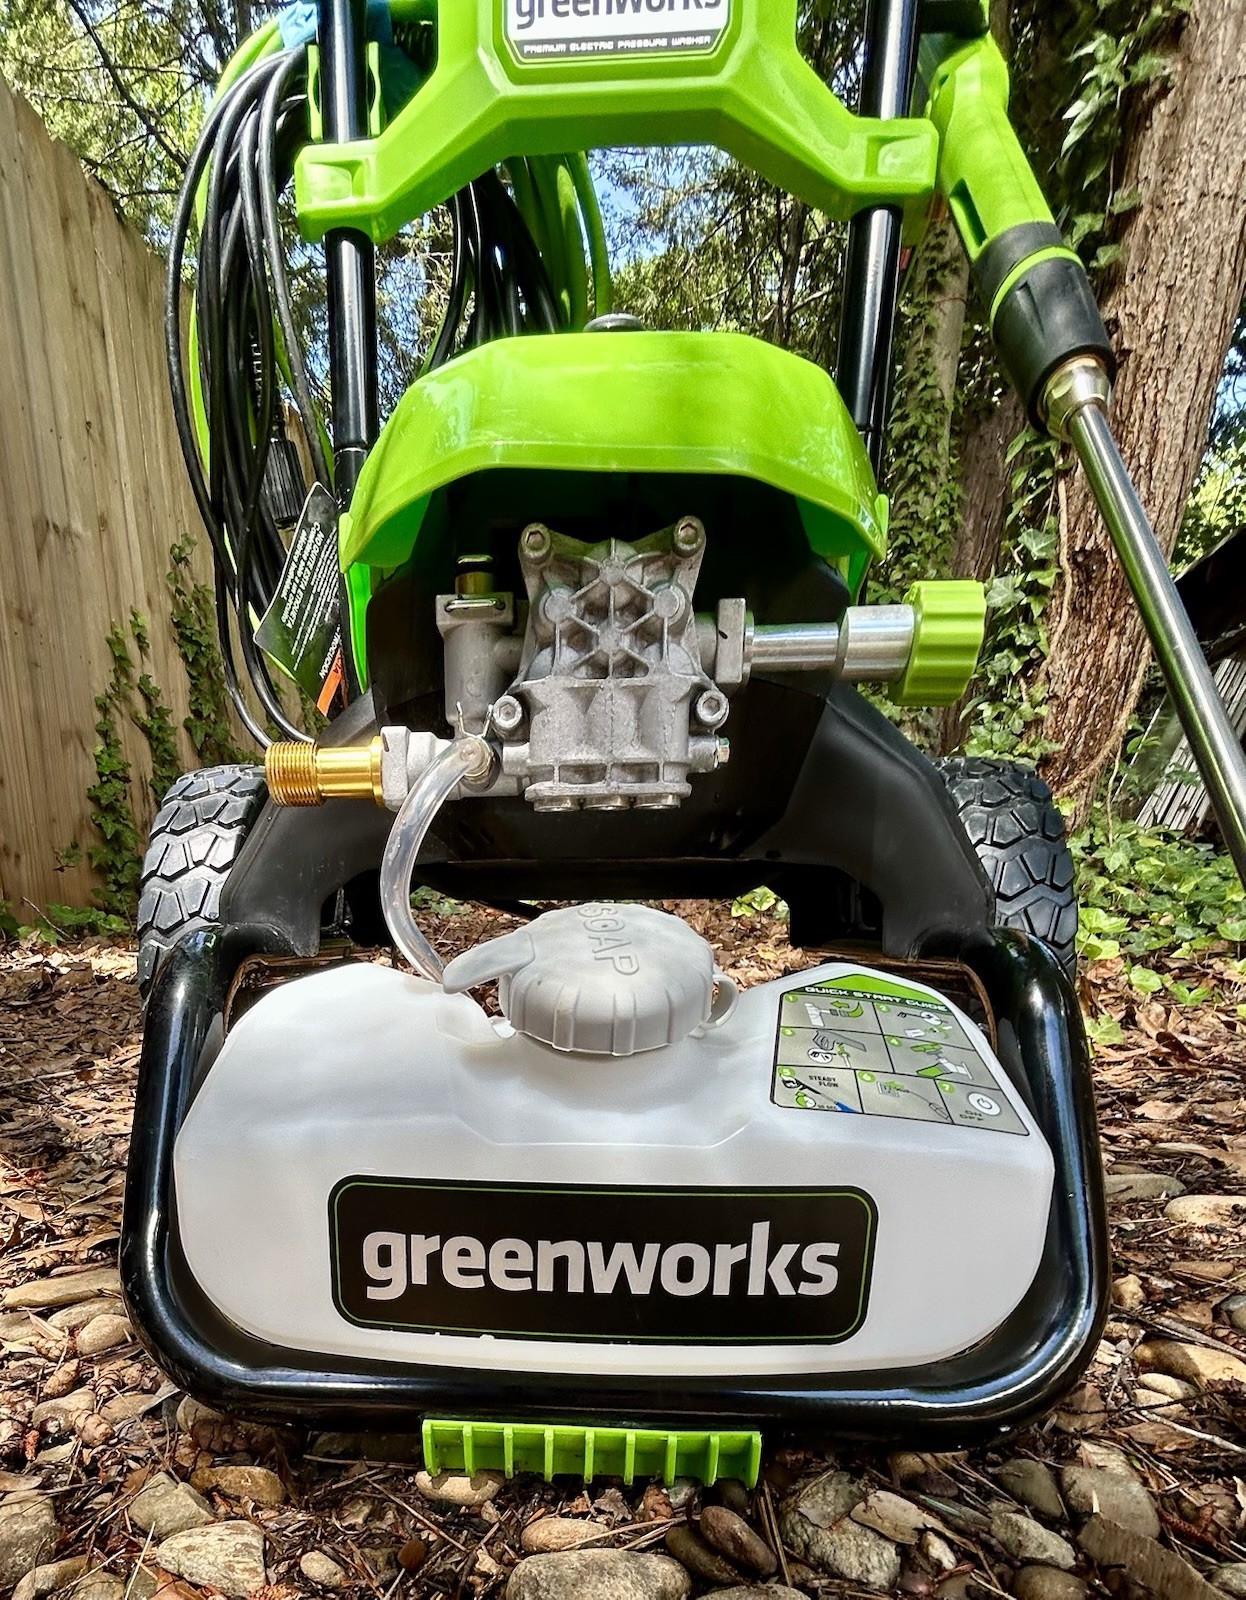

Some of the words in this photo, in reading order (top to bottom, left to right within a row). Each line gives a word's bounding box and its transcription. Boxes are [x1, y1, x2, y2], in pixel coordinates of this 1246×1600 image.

[516, 0, 721, 30] greenwo
[524, 43, 567, 54] PREMIUM
[569, 41, 614, 52] ELECTRIC
[617, 37, 668, 49] PRESSURE
[671, 35, 711, 46] WASHER
[315, 530, 324, 545] NO
[307, 543, 319, 571] QUITE
[299, 566, 311, 590] ESTA
[286, 588, 304, 629] ETIQUETA
[578, 903, 639, 975] SOAP
[804, 986, 849, 997] QUICK
[853, 991, 901, 1003] START
[905, 999, 948, 1012] GUIDE
[362, 1220, 840, 1301] greenworks
